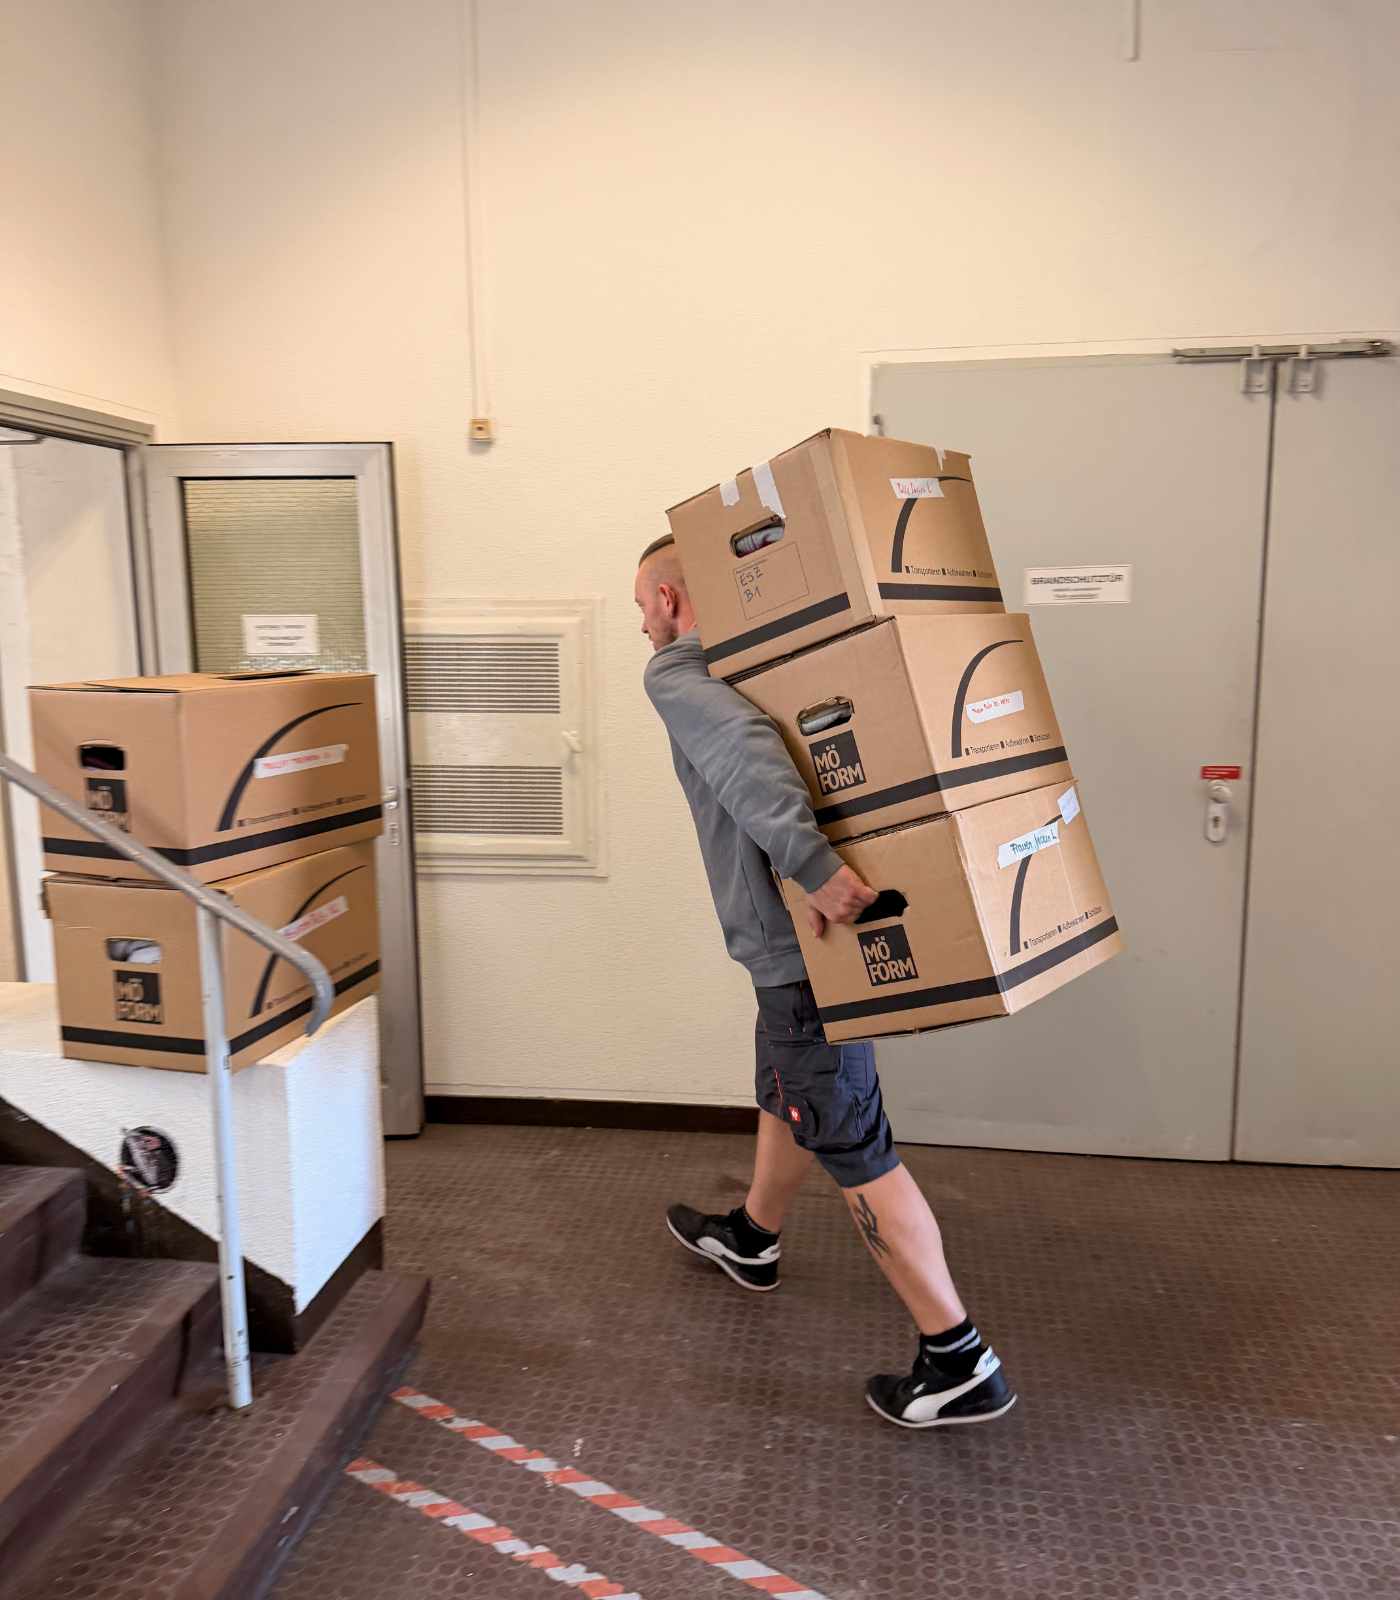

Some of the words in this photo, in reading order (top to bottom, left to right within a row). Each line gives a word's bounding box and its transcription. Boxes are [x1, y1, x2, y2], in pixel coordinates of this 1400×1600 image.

[814, 743, 841, 774] MÖ
[820, 762, 864, 793] FORM
[862, 935, 891, 964] MÖ
[868, 957, 916, 983] FORM
